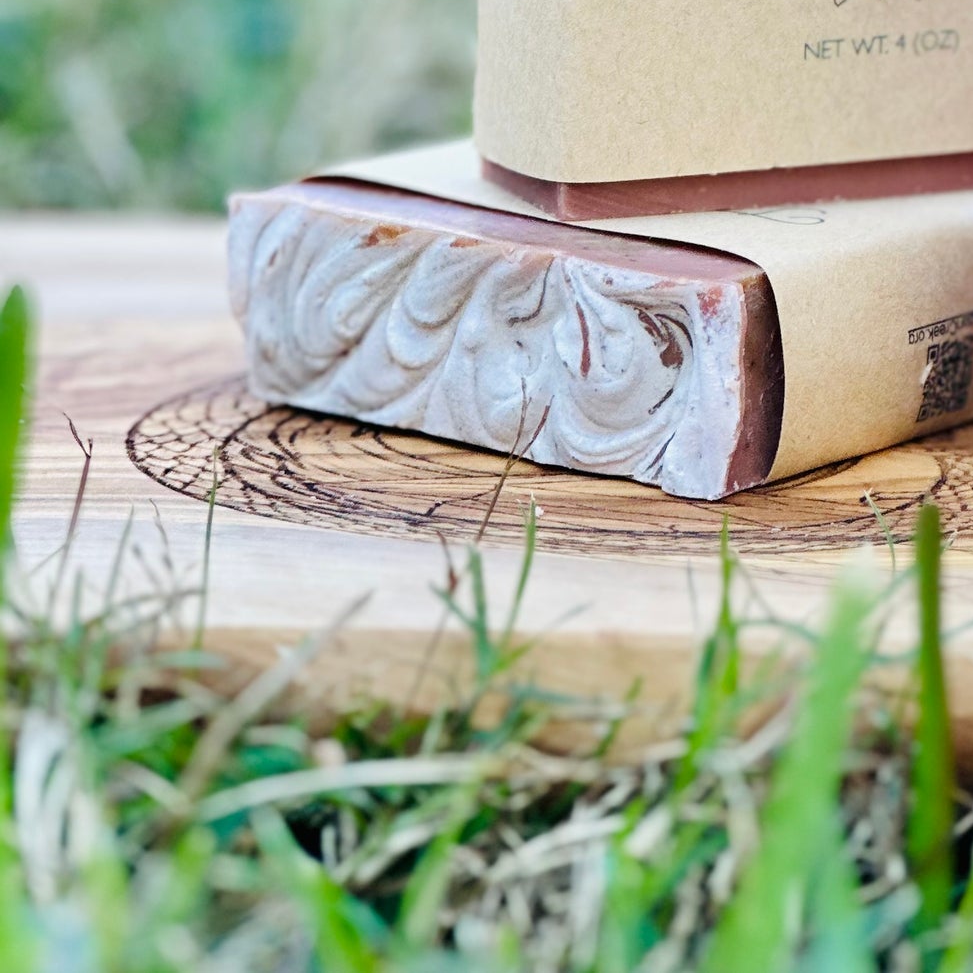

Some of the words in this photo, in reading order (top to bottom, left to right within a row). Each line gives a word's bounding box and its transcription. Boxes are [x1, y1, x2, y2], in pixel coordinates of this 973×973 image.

[804, 39, 844, 60] NET
[851, 35, 889, 55] WT.
[896, 33, 905, 49] 4
[913, 29, 960, 55] (OZ)
